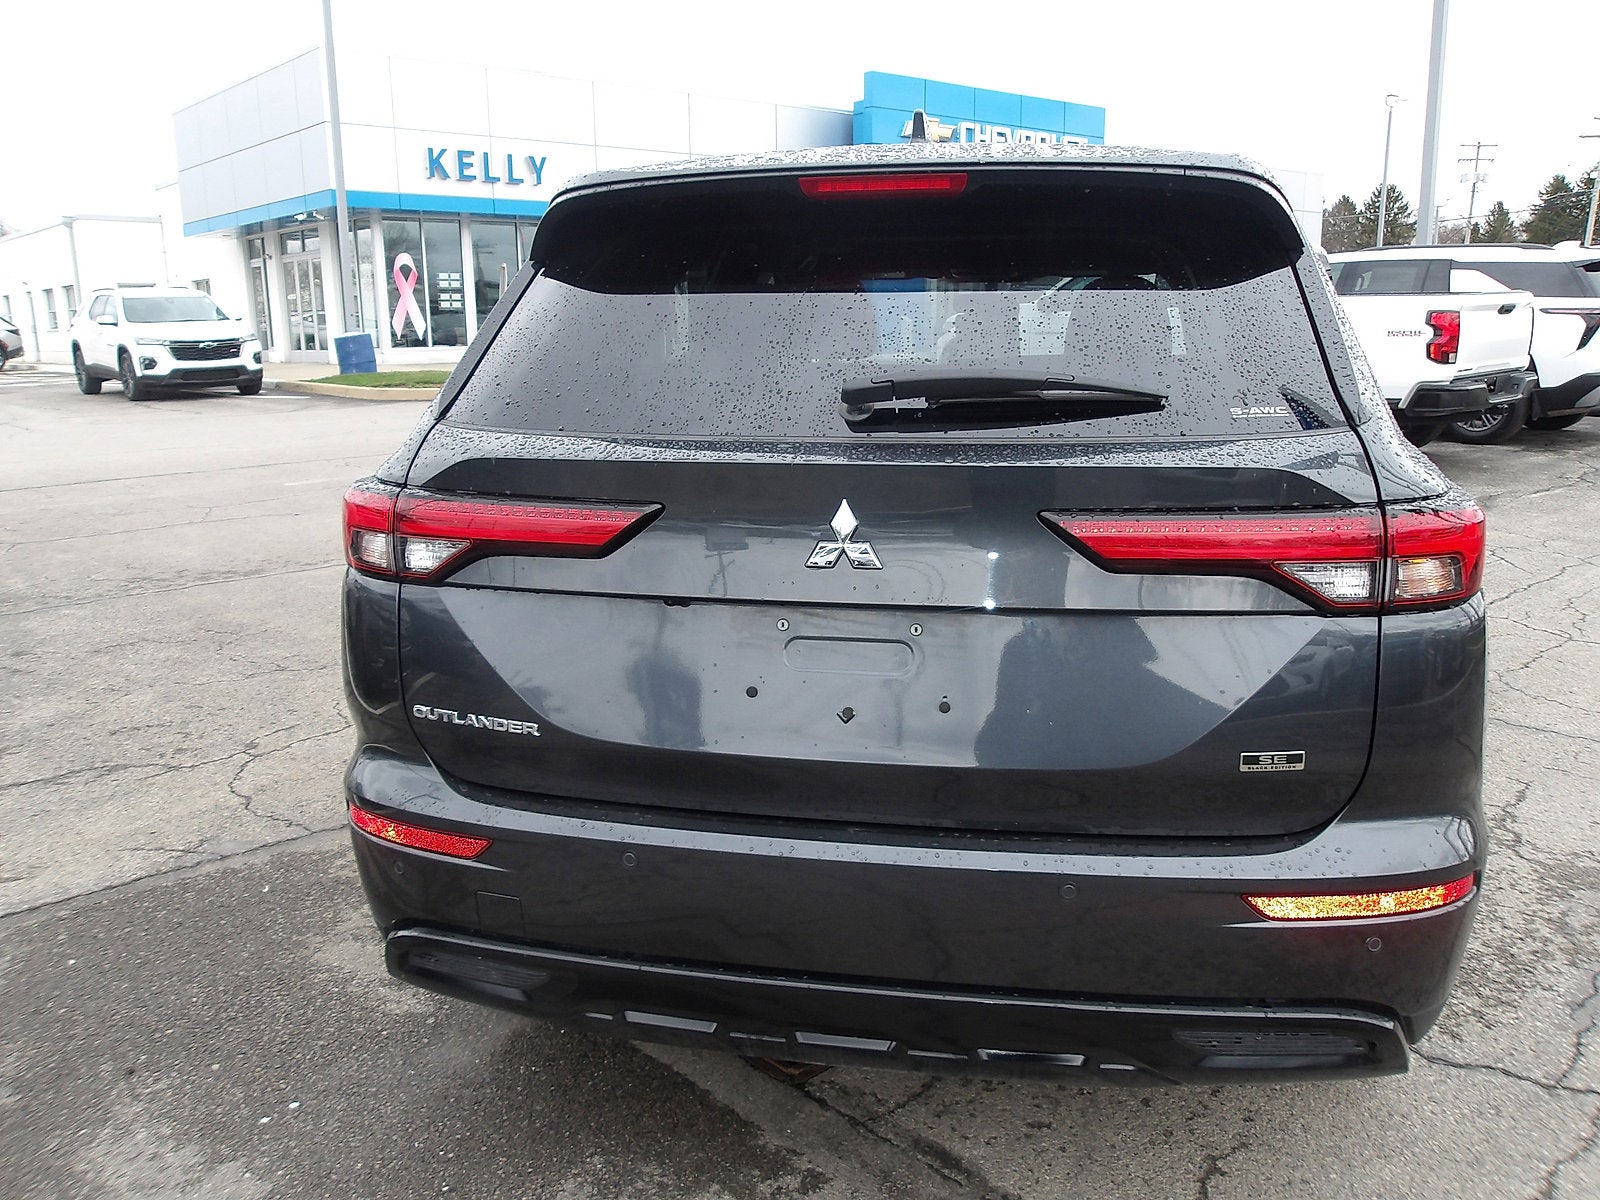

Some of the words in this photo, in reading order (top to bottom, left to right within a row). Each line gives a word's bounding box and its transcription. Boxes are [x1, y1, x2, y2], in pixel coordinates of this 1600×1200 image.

[426, 147, 547, 185] KELLY
[1229, 406, 1288, 415] S-AWC
[412, 704, 541, 737] OUTLANDER
[1258, 755, 1288, 765] SE
